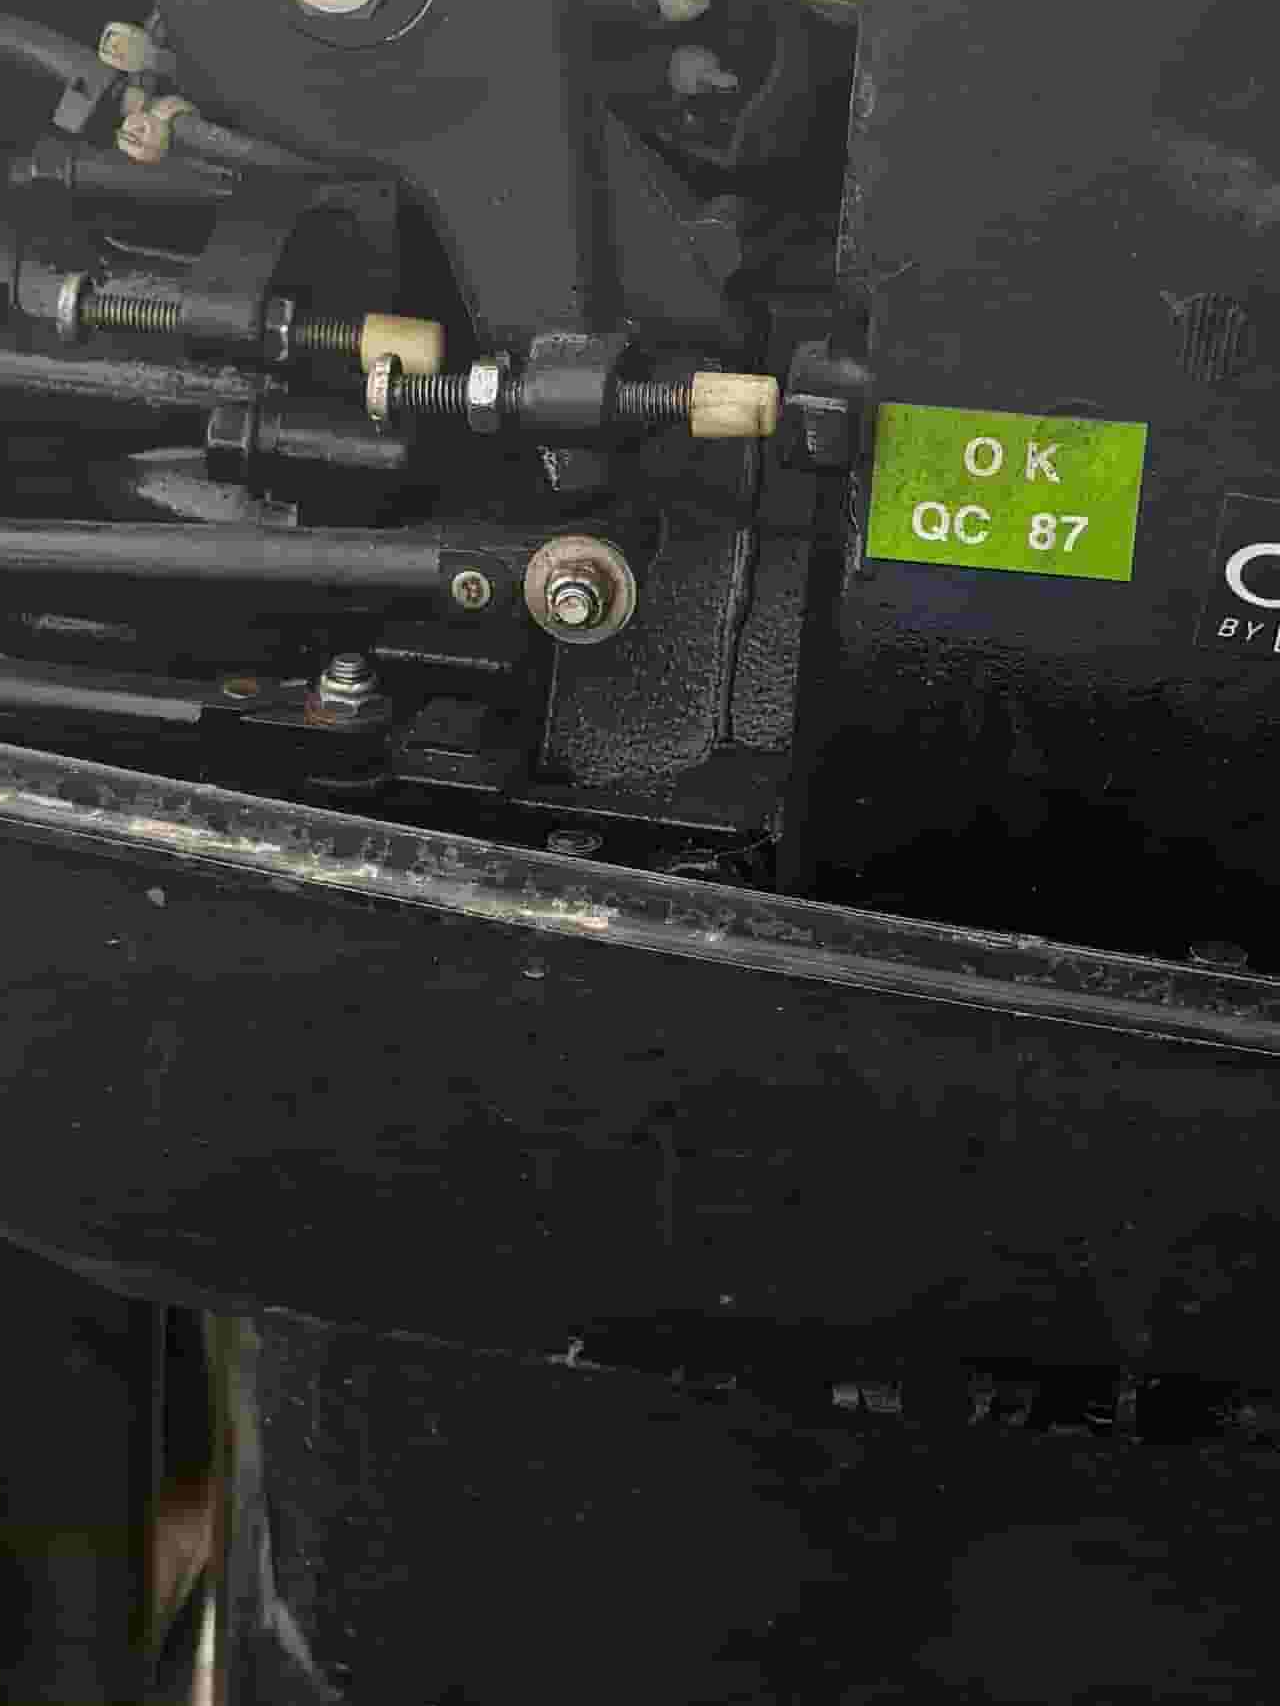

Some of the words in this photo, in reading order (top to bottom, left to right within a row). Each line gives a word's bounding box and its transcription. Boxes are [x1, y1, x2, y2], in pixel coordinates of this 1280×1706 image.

[911, 499, 992, 545] QC
[1027, 512, 1089, 553] 87
[1218, 615, 1266, 643] BY
